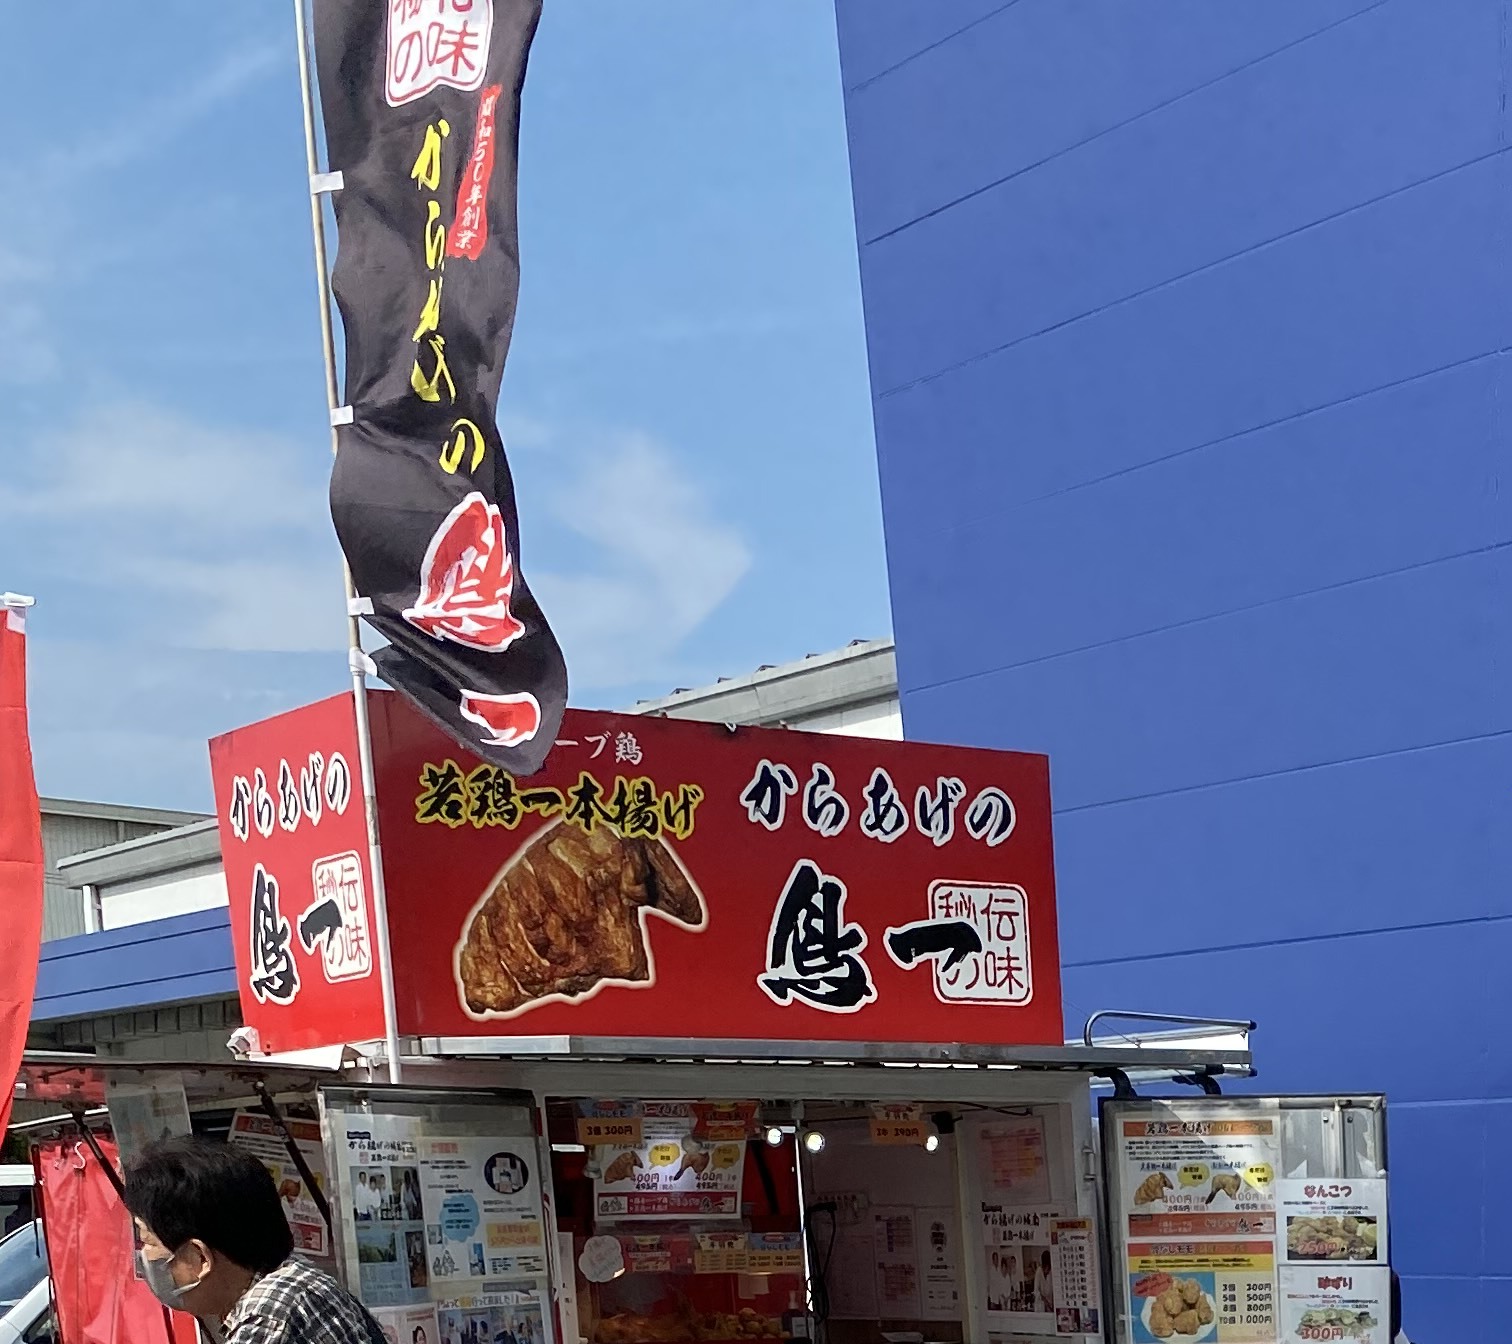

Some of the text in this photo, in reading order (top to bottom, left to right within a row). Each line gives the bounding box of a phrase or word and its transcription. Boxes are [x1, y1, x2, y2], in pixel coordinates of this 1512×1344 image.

[229, 751, 351, 842] からあげの
[416, 758, 703, 842] 若鶏一本揚げ
[741, 758, 1017, 847] からあげの
[604, 1125, 633, 1135] 300円
[1304, 1184, 1353, 1198] なんこつ
[1222, 1283, 1272, 1292] 3個 300円
[1222, 1293, 1272, 1302] 5個 500円
[1246, 1304, 1272, 1312] 800円
[1218, 1315, 1273, 1325] 10個 1000円
[1300, 1327, 1344, 1341] 300円
